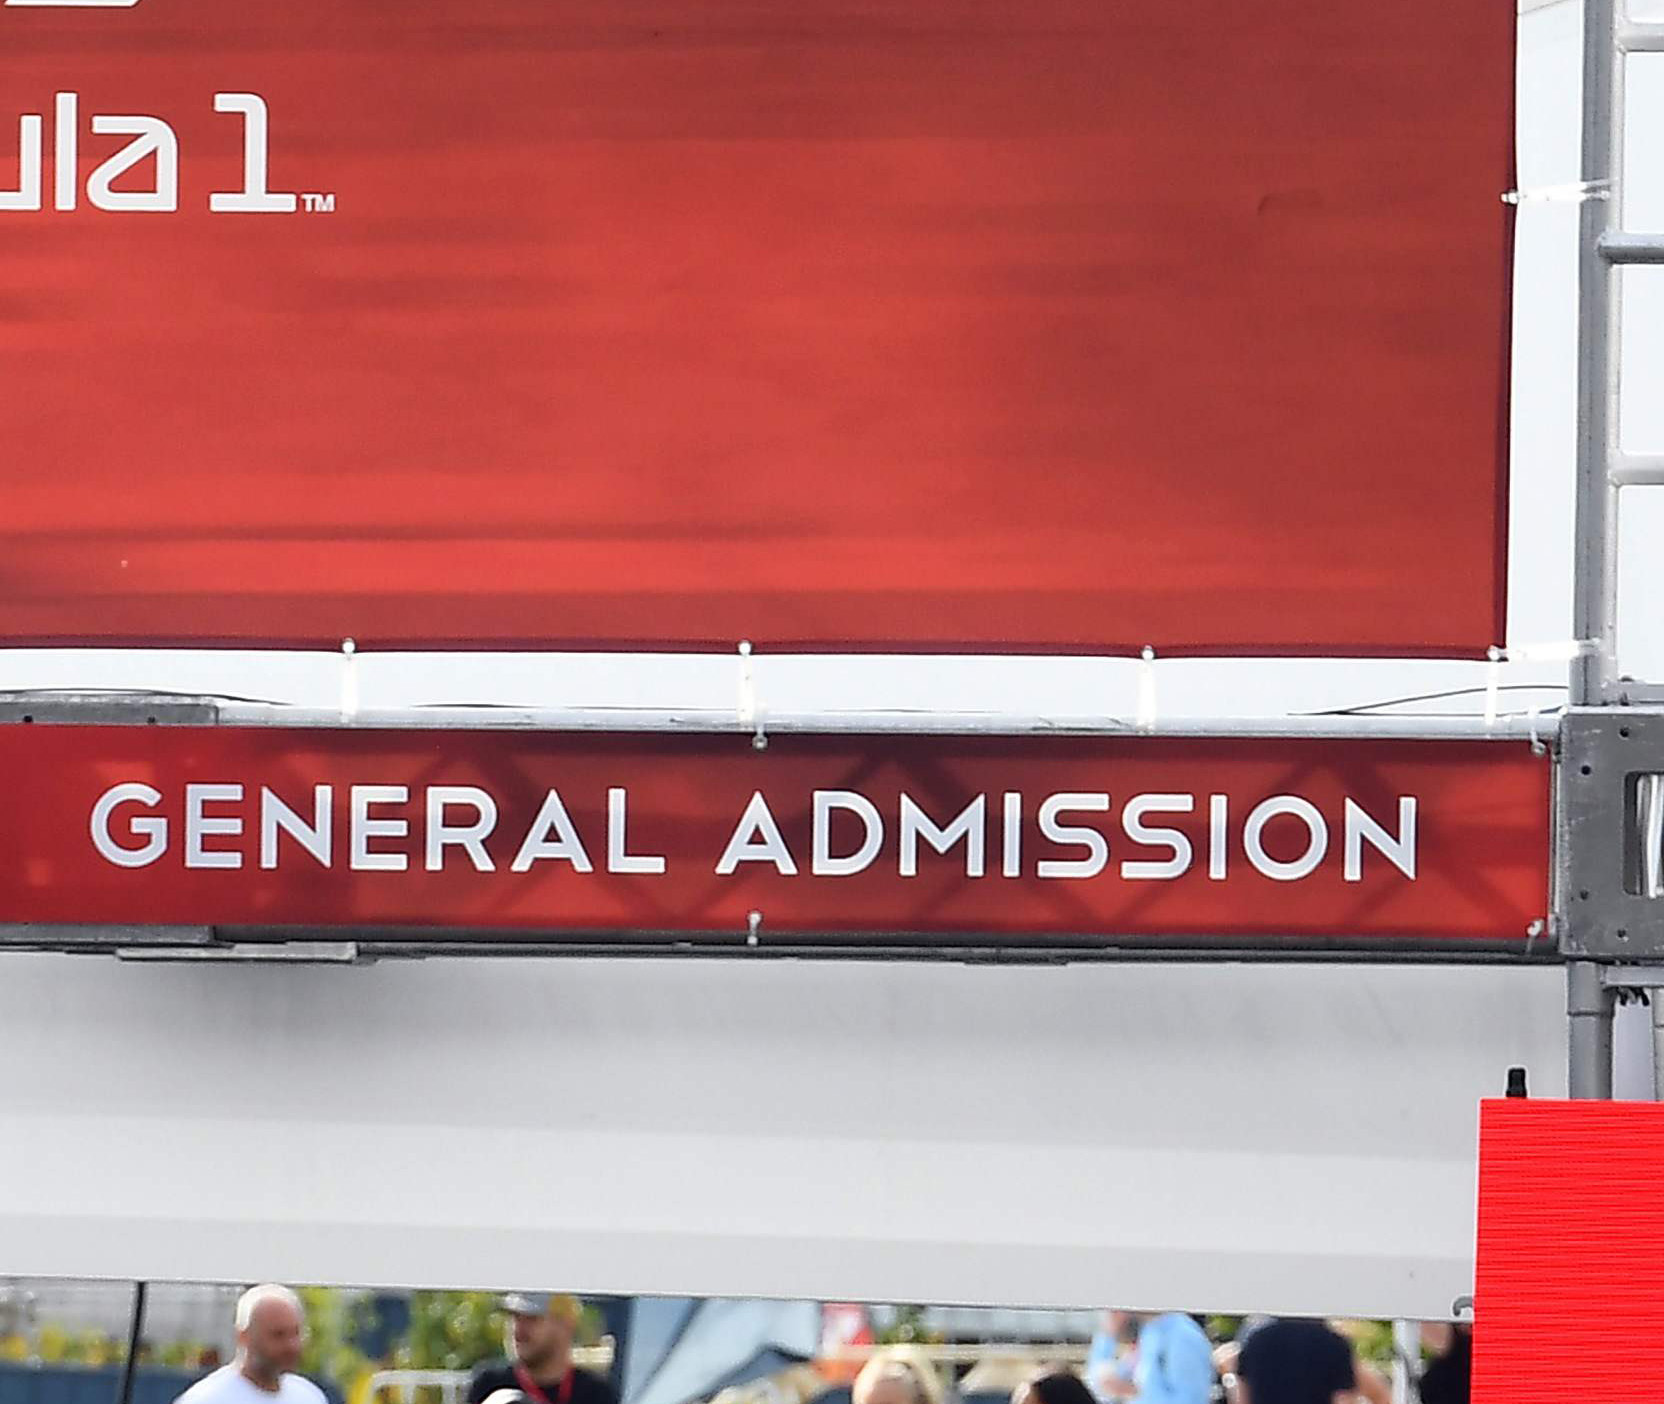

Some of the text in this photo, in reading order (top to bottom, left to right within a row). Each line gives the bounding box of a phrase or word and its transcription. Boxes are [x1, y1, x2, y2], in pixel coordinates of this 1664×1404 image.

[209, 93, 298, 213] 1
[89, 782, 1418, 882] GENERAL ADMISSION
